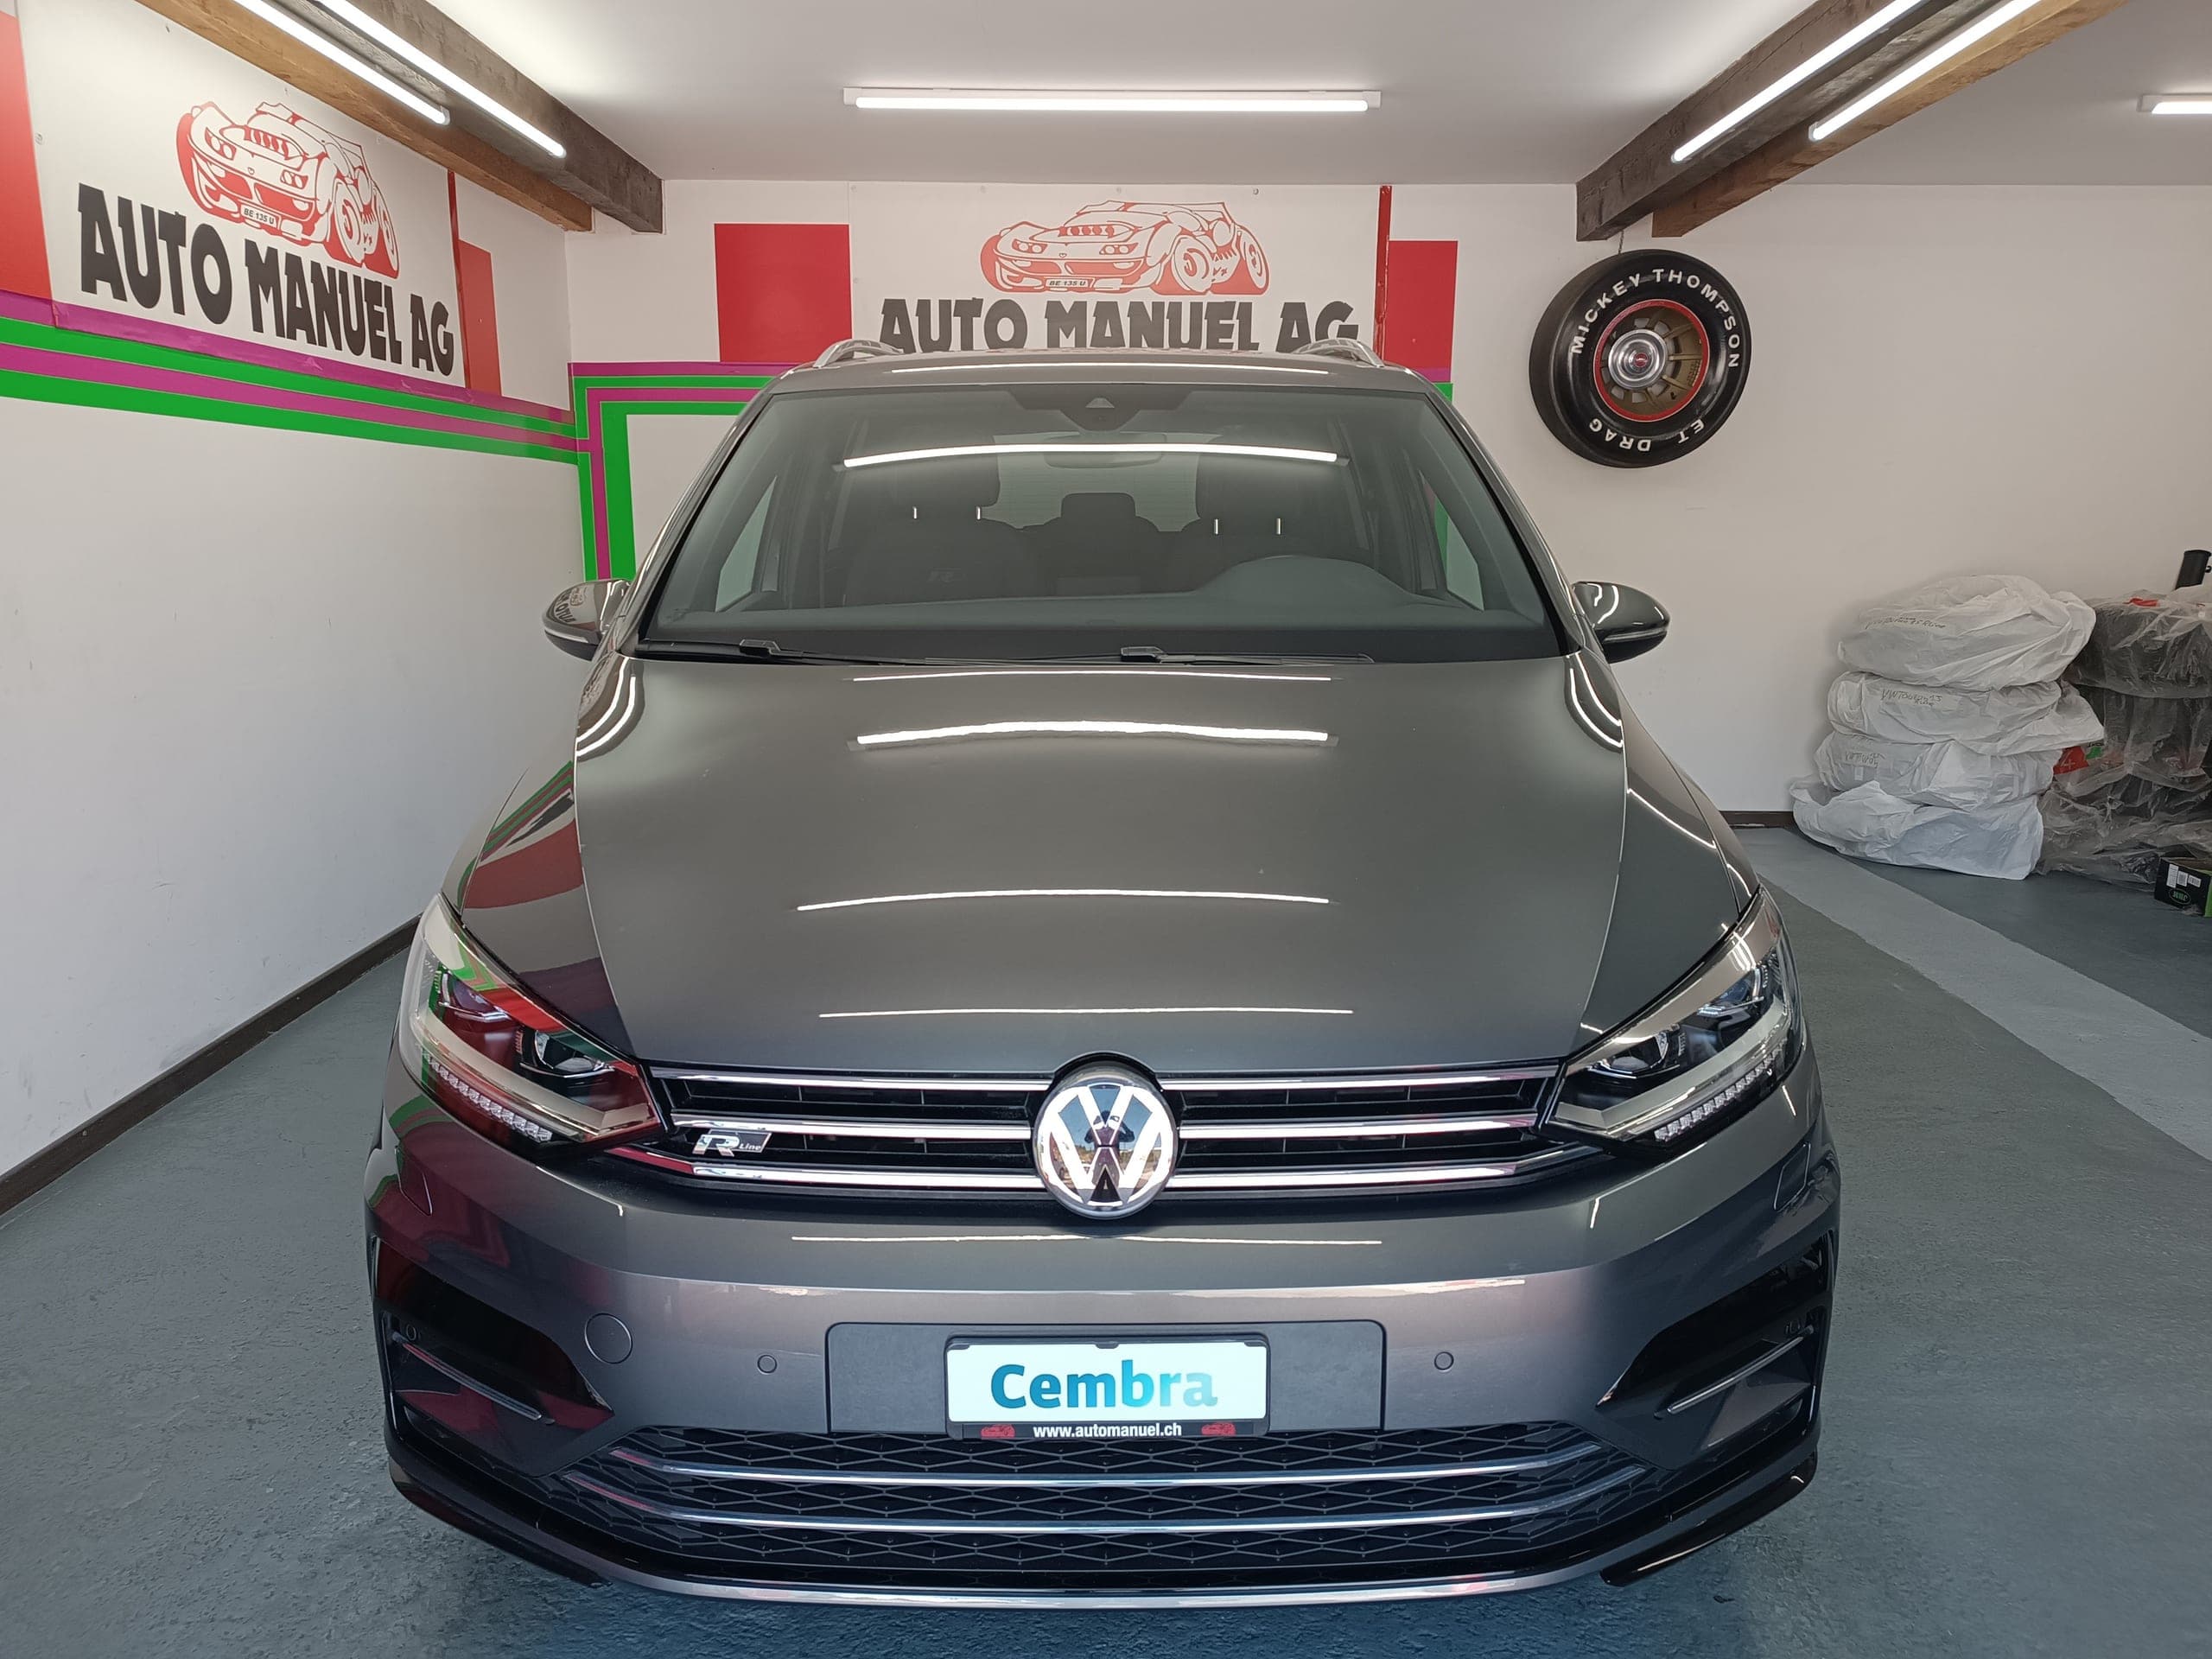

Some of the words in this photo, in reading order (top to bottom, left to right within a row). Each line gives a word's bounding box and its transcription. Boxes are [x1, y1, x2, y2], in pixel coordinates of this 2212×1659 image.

[244, 207, 253, 218] BE
[78, 182, 232, 324] AUTO
[245, 238, 402, 365] MANUEL
[410, 293, 454, 376] AG
[880, 297, 1027, 353] AUTO
[1044, 300, 1260, 351] MANUEL
[1275, 301, 1358, 353] AG
[1570, 272, 1641, 354] MICKEY
[1652, 268, 1740, 368] THOMPSON
[1589, 418, 1651, 452] DRAG
[739, 1142, 761, 1151] Line
[990, 1359, 1218, 1408] Cembra
[1033, 1422, 1182, 1438] www.automanuel.ch
